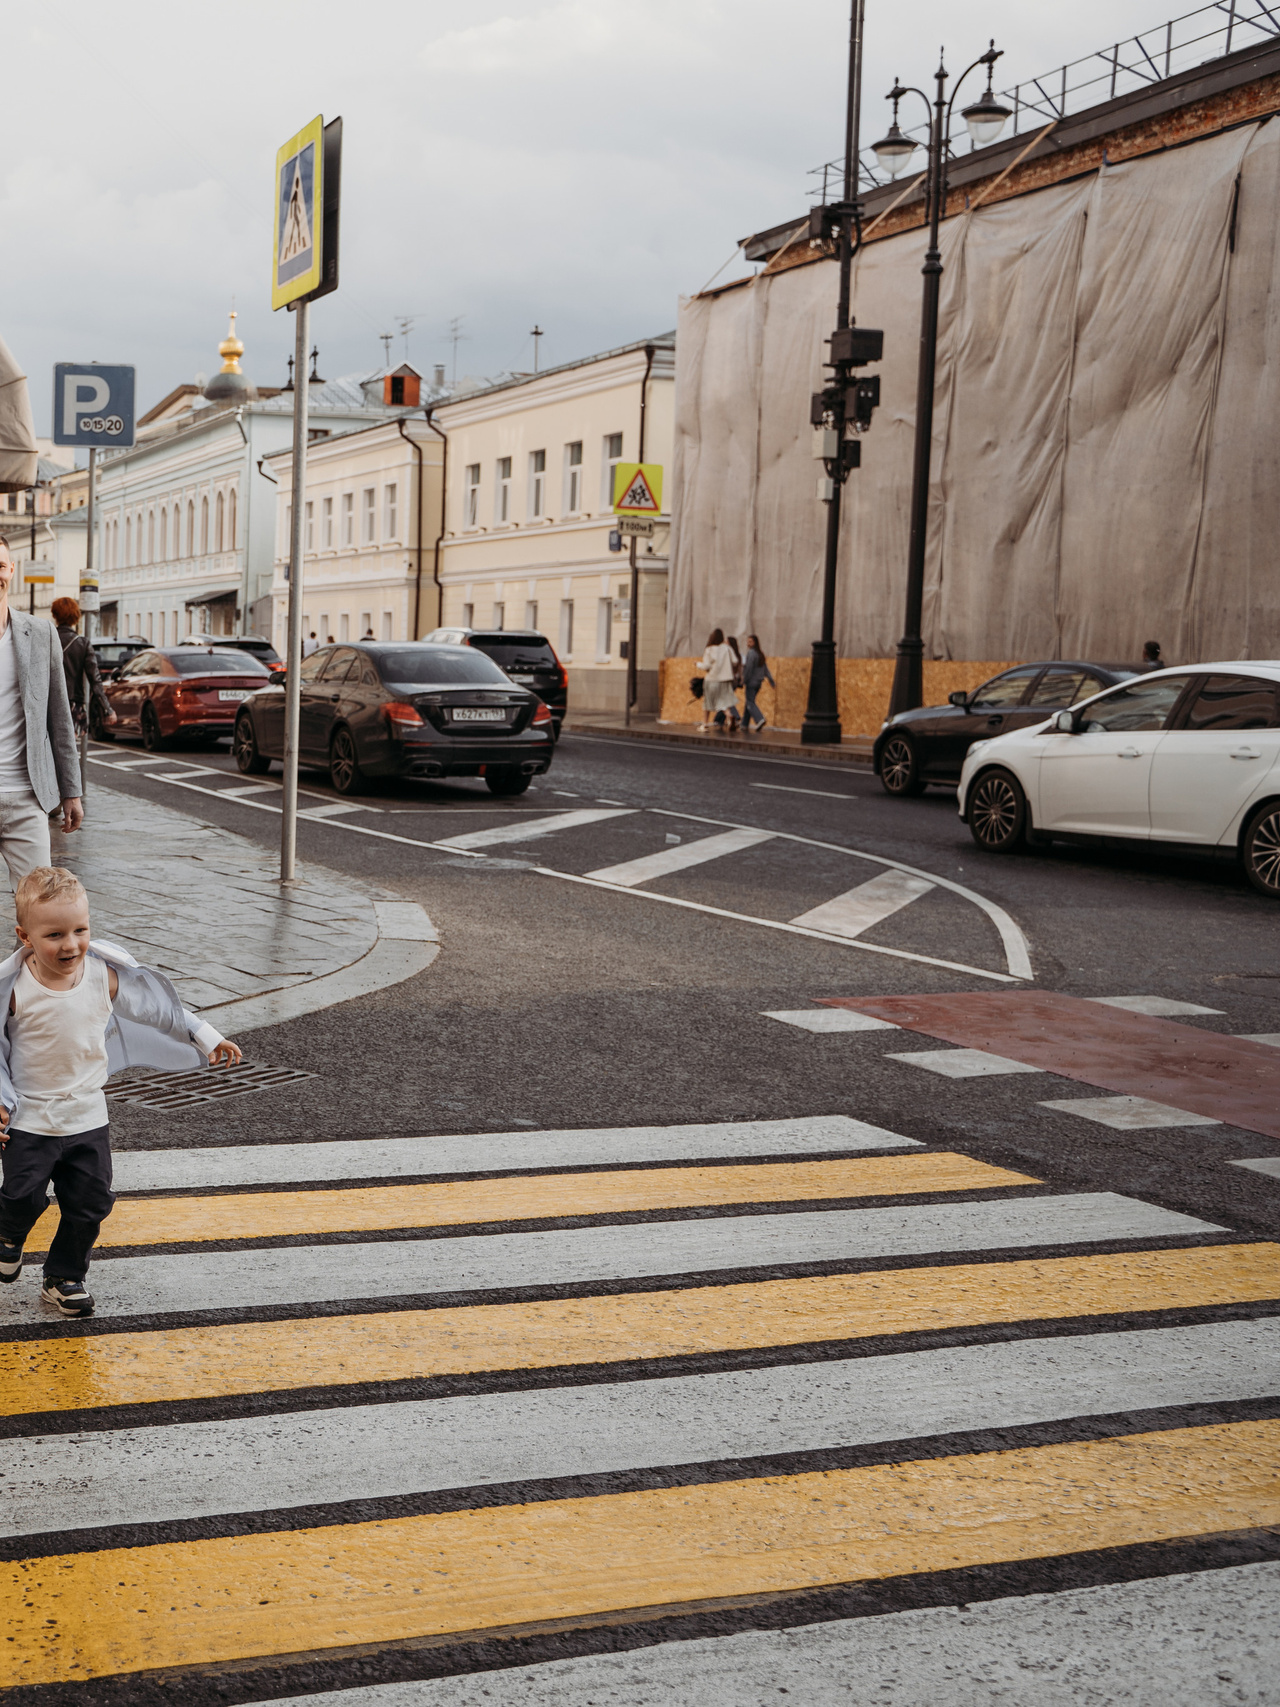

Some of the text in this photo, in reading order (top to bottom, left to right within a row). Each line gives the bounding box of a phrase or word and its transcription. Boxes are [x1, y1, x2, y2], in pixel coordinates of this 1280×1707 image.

[63, 374, 111, 436] P
[82, 419, 122, 431] 10 15 20
